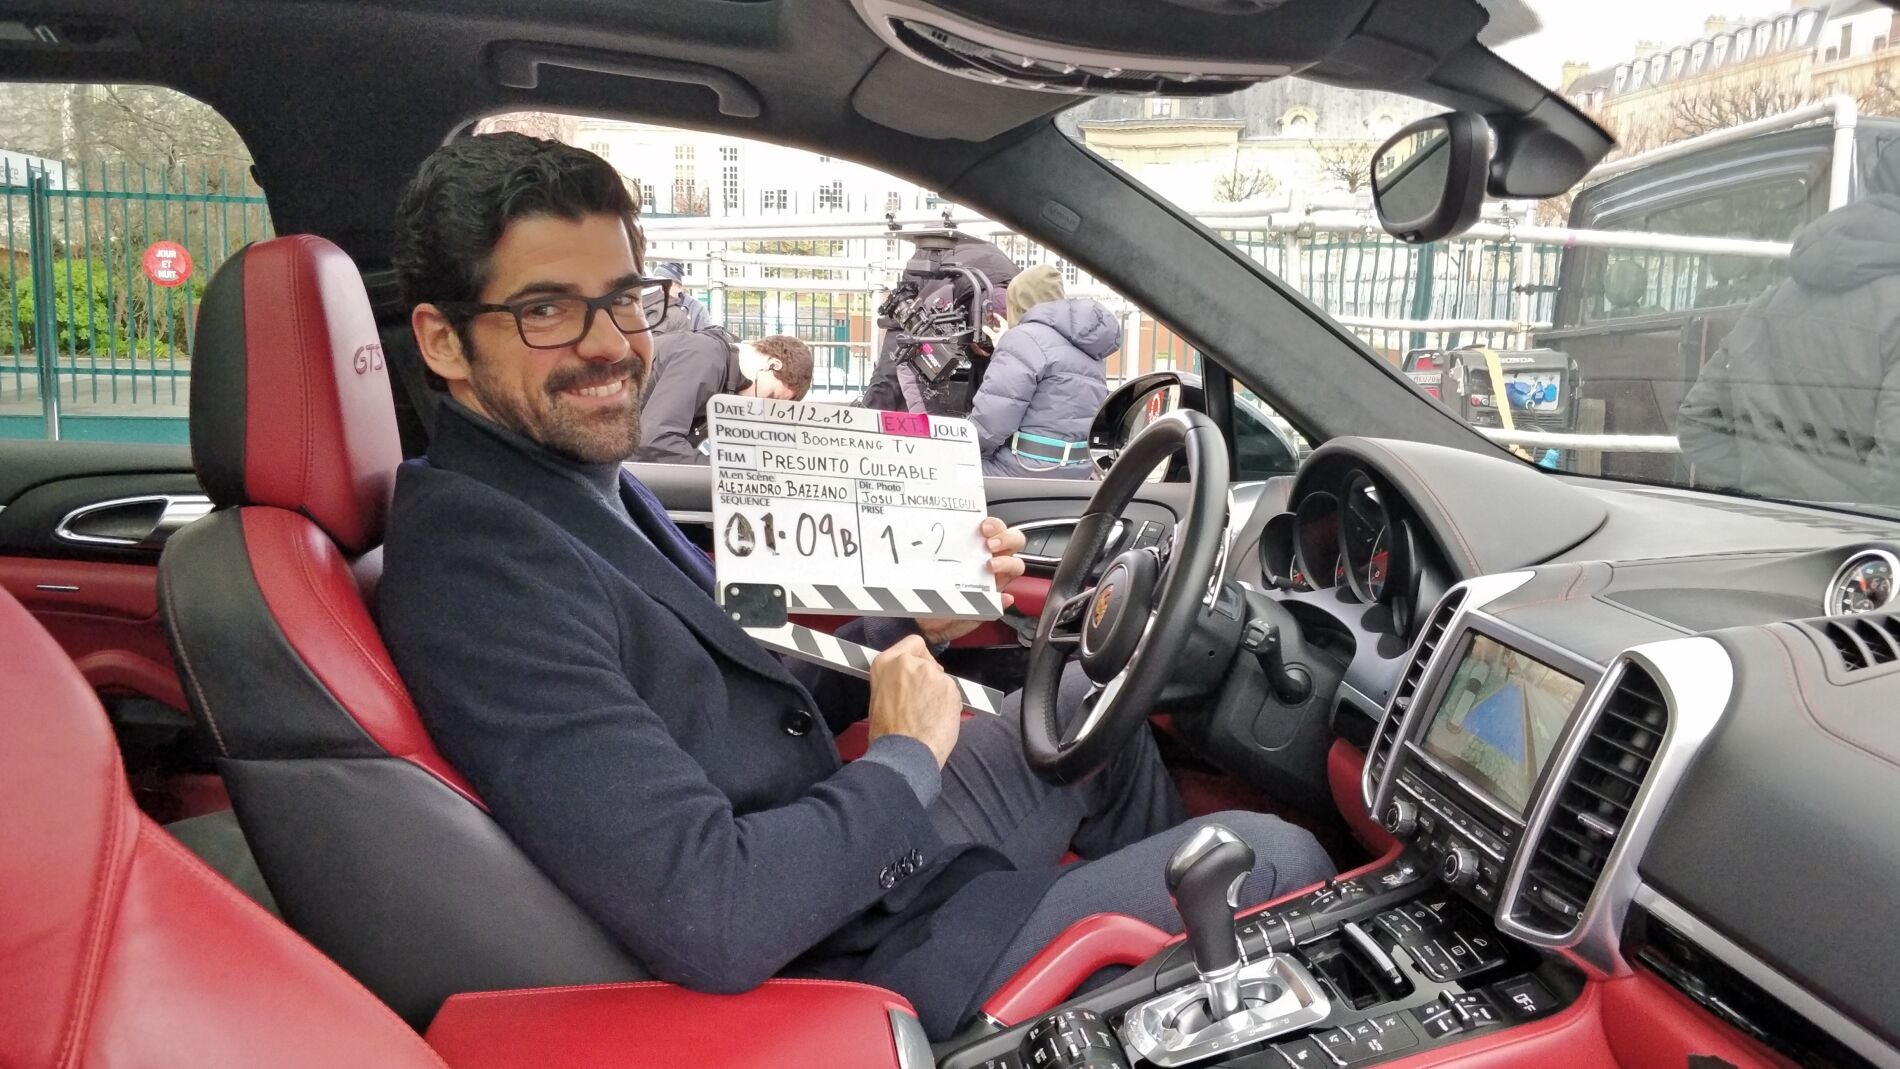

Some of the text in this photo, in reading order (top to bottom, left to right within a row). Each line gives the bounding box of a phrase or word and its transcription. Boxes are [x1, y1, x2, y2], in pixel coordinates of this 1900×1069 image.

[156, 249, 177, 258] JOUR
[161, 260, 172, 268] ET
[157, 270, 177, 279] NUIT
[353, 343, 384, 375] GTS
[714, 401, 746, 416] DATE
[715, 424, 797, 443] PRODUCTION
[933, 423, 968, 438] JOUR
[801, 431, 916, 455] BOOMERANG TV
[717, 449, 747, 463] FILM
[762, 450, 939, 481] PRESUNTO CULPABLE
[717, 480, 848, 500] ALEJANDRO BAZZANO
[876, 482, 903, 493] Photo
[720, 495, 772, 508] SEQUENCE
[861, 505, 885, 515] PRISE
[1512, 993, 1537, 1013] OFF
